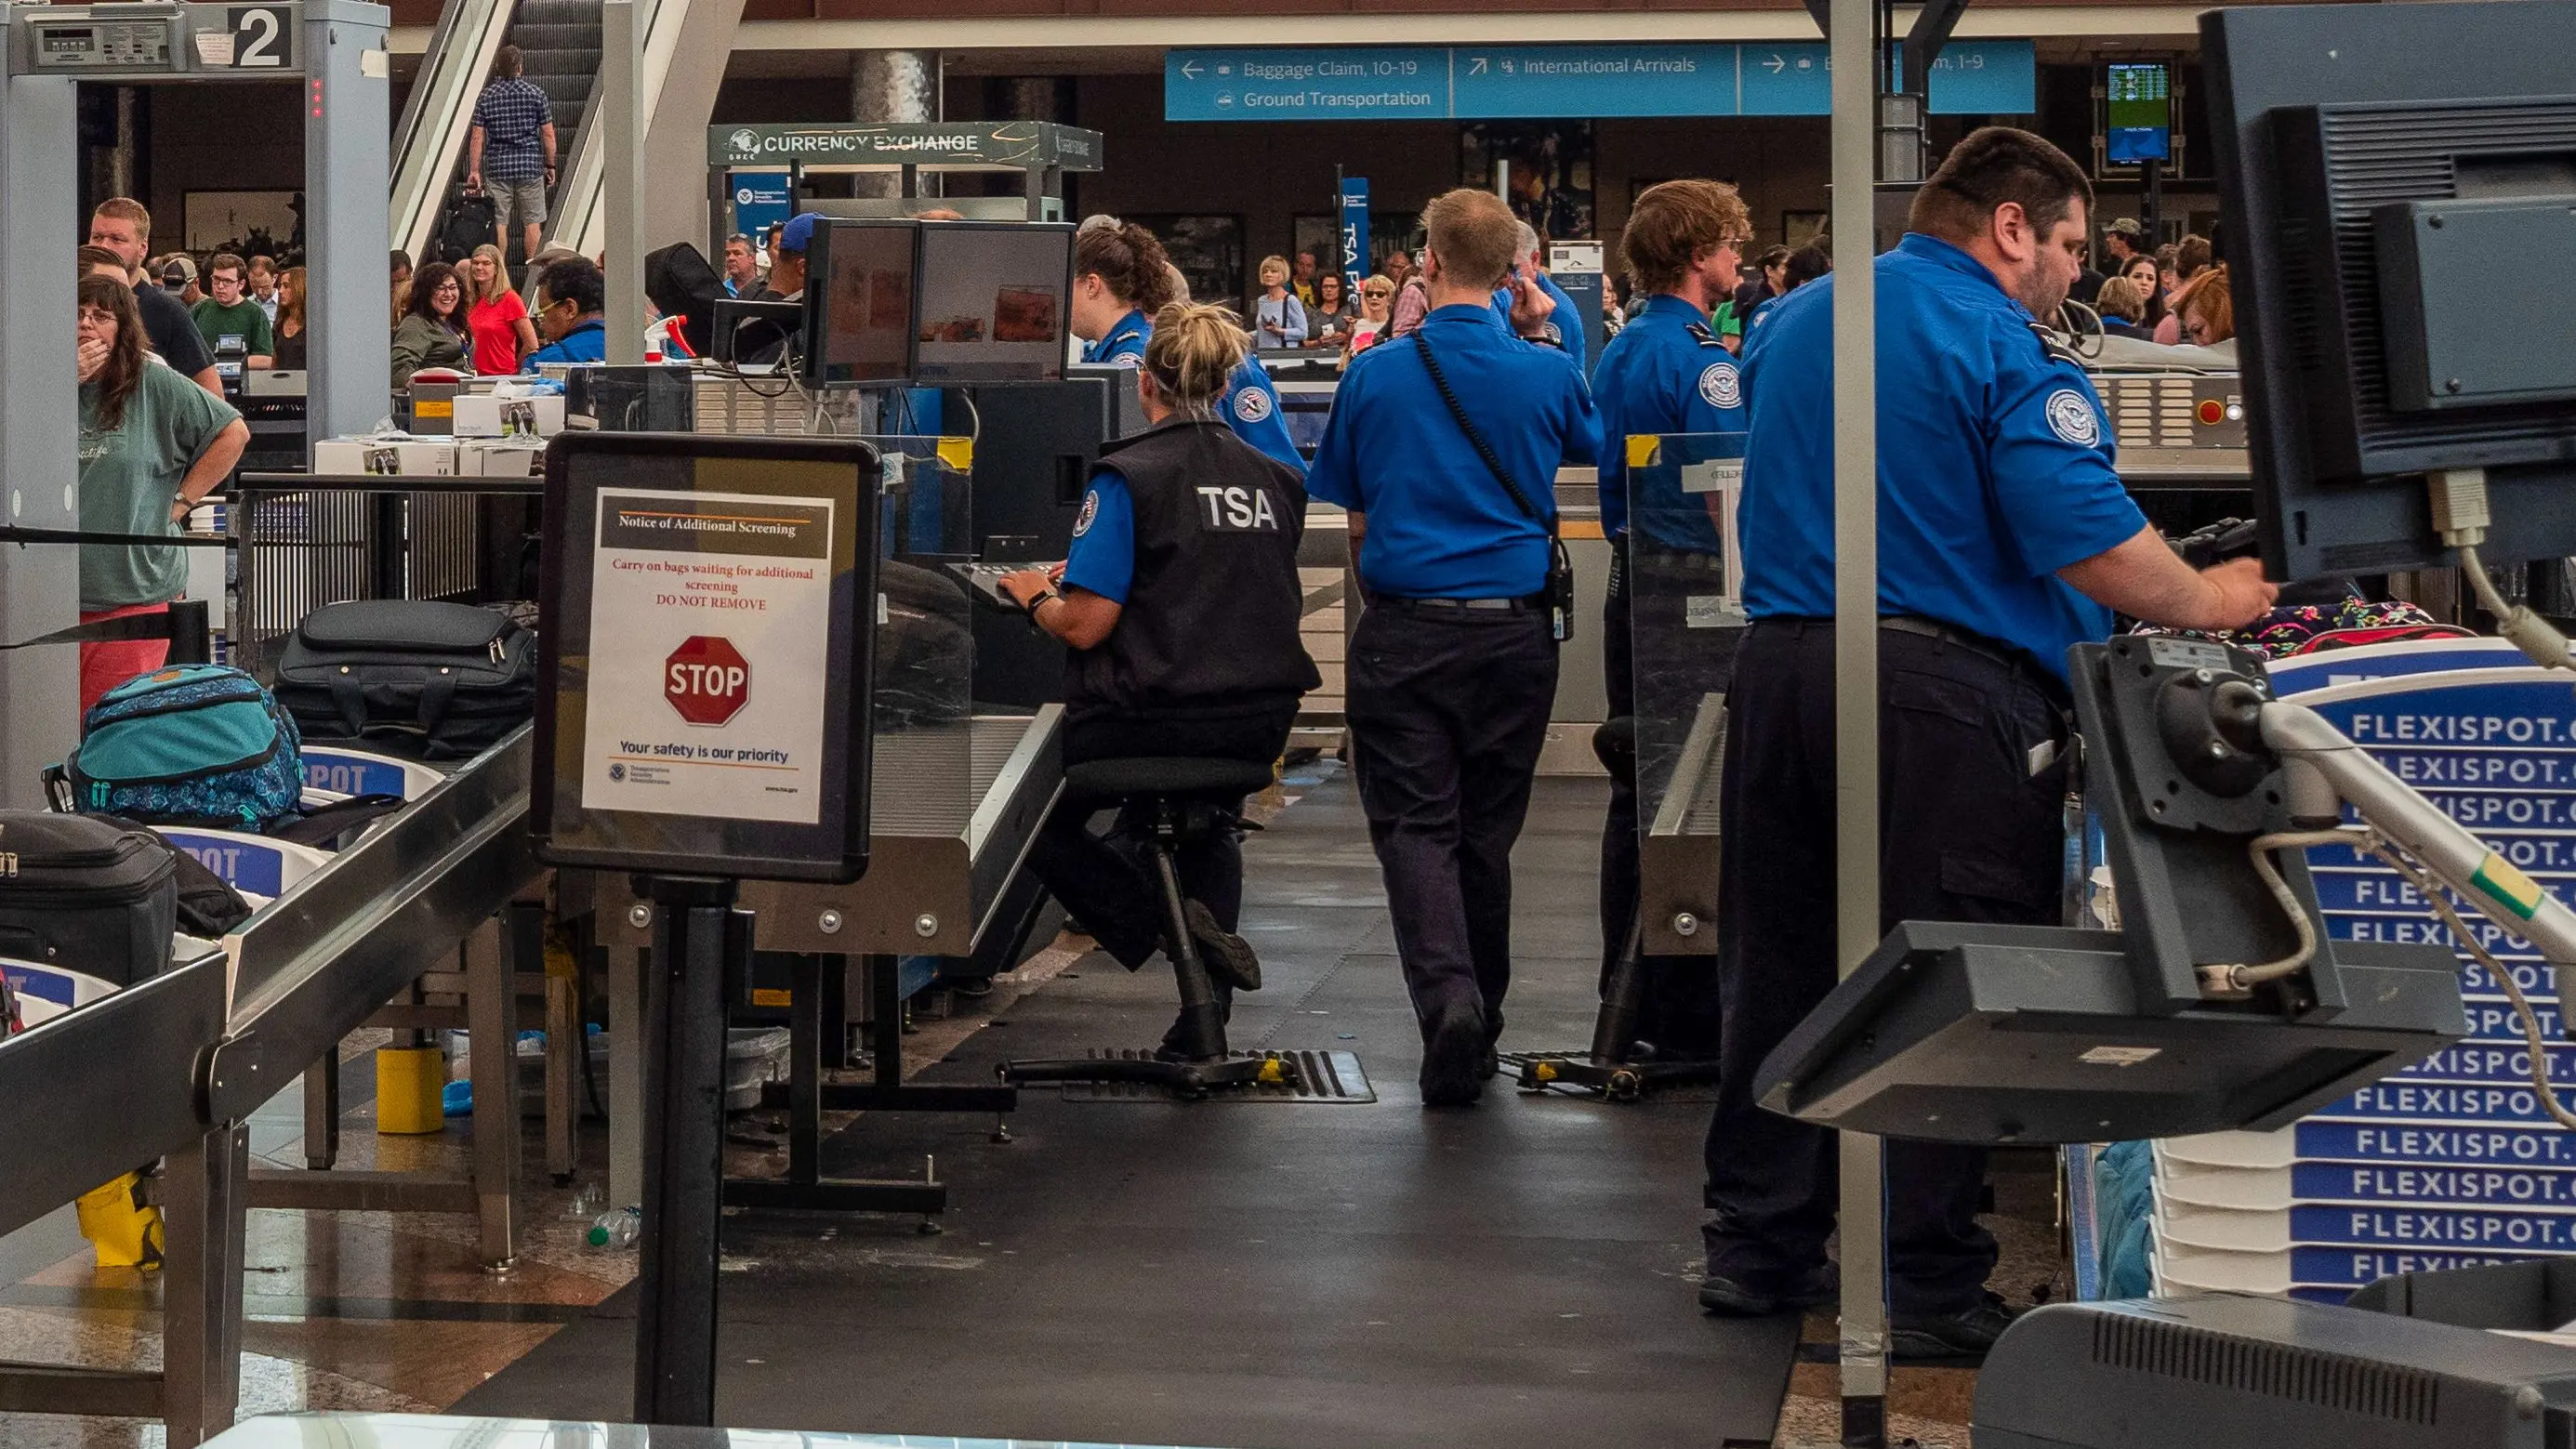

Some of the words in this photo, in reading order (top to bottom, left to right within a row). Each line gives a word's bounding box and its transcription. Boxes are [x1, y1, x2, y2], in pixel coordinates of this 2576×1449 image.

[240, 9, 280, 65] 2
[1244, 62, 1314, 80] Baggage
[1318, 61, 1367, 77] Claim,
[1373, 61, 1418, 75] 10-19
[1525, 59, 1628, 73] International
[1633, 58, 1697, 72] Arrivals
[1959, 54, 1984, 70] 1-9
[1244, 92, 1304, 107] Ground
[1309, 91, 1431, 109] Transportation
[764, 136, 868, 151] CURRENCY
[874, 135, 979, 151] EXCHANGE
[1343, 222, 1358, 265] TSA
[1196, 486, 1278, 530] TSA
[619, 515, 656, 528] Notice
[659, 517, 672, 529] of
[674, 518, 736, 533] Additional
[738, 521, 797, 538] Screening
[613, 559, 643, 573] Carry
[665, 561, 689, 575] bags
[693, 563, 733, 578] waiting
[736, 565, 753, 576] for
[756, 566, 813, 580] additional
[685, 581, 738, 595] screening
[657, 594, 677, 605] DO
[680, 596, 707, 607] NOT
[710, 598, 766, 611] REMOVE
[669, 663, 745, 697] STOP
[620, 741, 650, 754] Your
[654, 744, 694, 758] safety
[698, 744, 707, 757] is
[712, 747, 733, 759] our
[737, 747, 788, 764] priority
